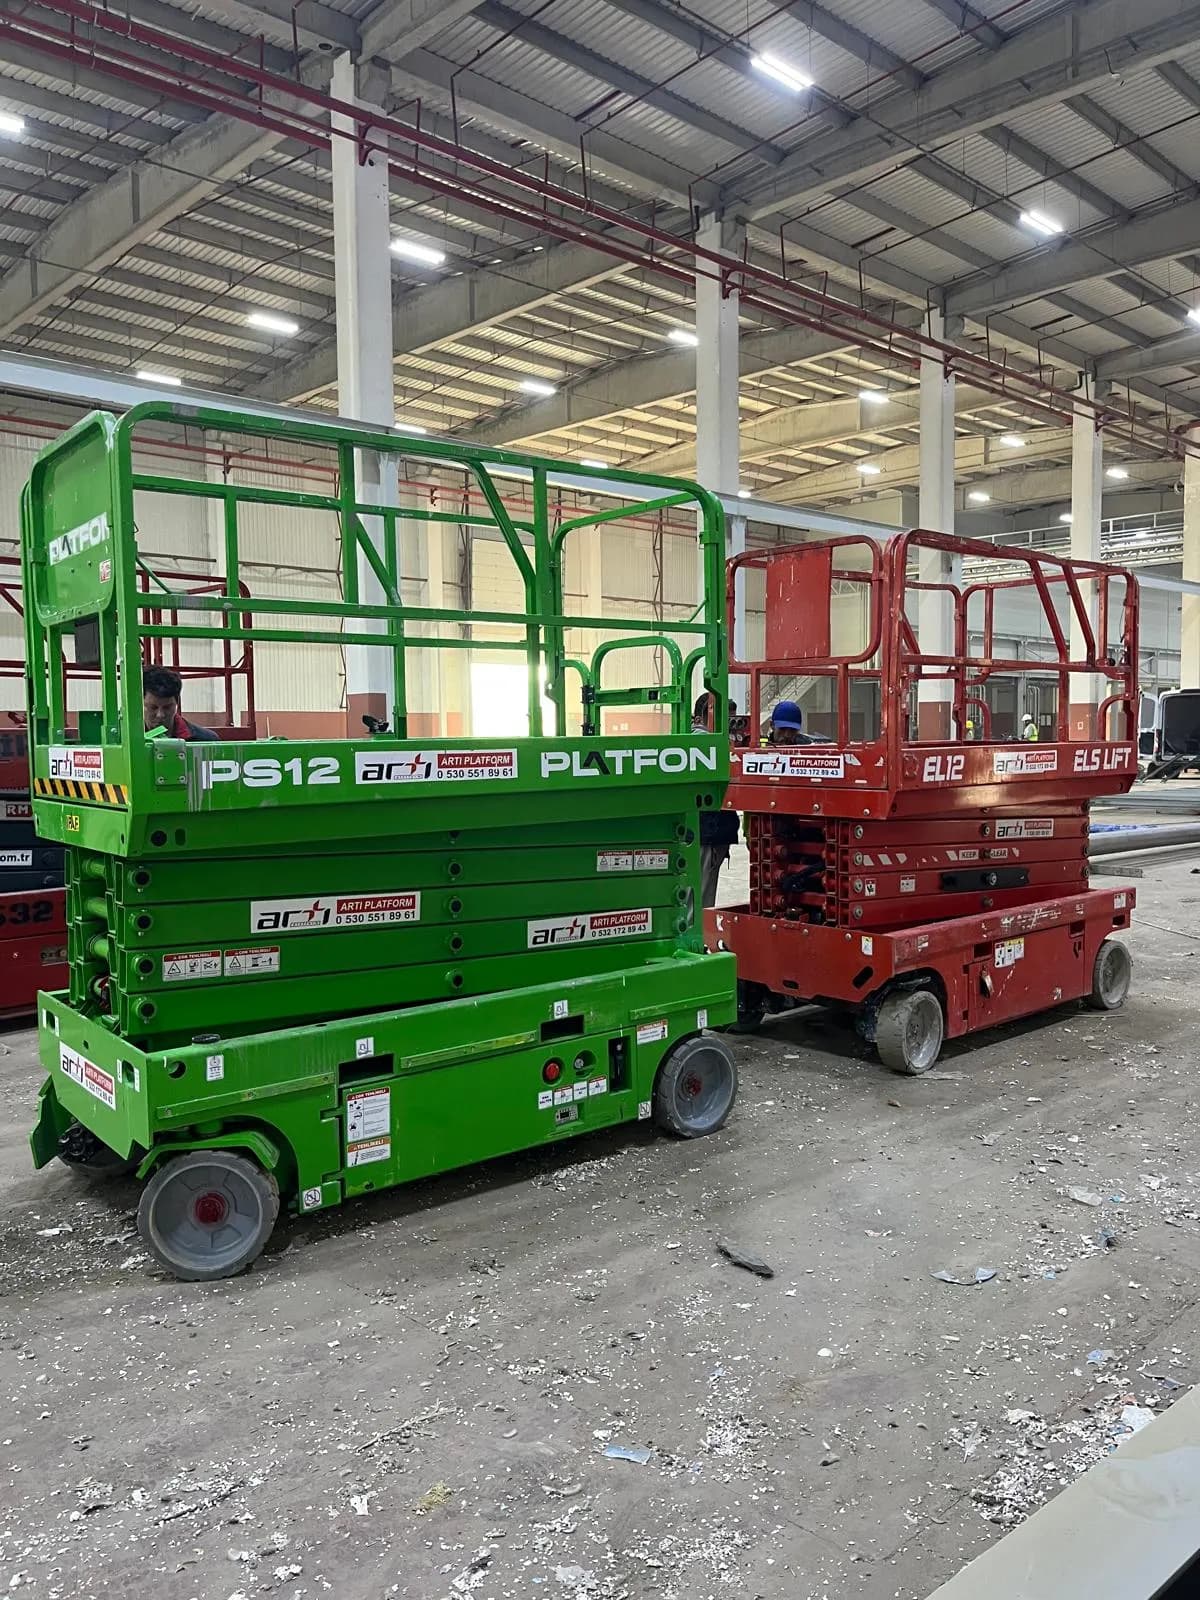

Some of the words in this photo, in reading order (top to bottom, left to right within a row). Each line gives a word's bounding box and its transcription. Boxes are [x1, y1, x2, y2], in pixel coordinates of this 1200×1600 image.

[441, 756, 463, 767] ARTI
[464, 755, 510, 766] PLATFORM
[540, 747, 716, 778] PLATFON
[806, 759, 839, 767] PLATFORM
[1073, 749, 1102, 772] ELS
[1103, 748, 1132, 770] LIFT
[202, 757, 340, 789] PS12
[437, 770, 444, 779] 0
[447, 769, 465, 779] 530
[468, 769, 485, 778] 551
[488, 768, 500, 778] 89
[503, 768, 514, 777] 61
[923, 755, 964, 782] EL12
[340, 900, 363, 912] ARTI
[364, 898, 413, 910] PLATFORM
[335, 915, 342, 925] 0
[346, 914, 365, 924] 530
[367, 912, 385, 923] 551
[389, 911, 401, 921] 89
[404, 910, 416, 920] 61
[592, 918, 609, 928] ARTI
[610, 913, 647, 925] PLATFORM
[591, 930, 596, 938] 0
[598, 928, 611, 937] 532
[613, 927, 626, 935] 172
[627, 925, 636, 934] 89
[637, 924, 647, 932] 43
